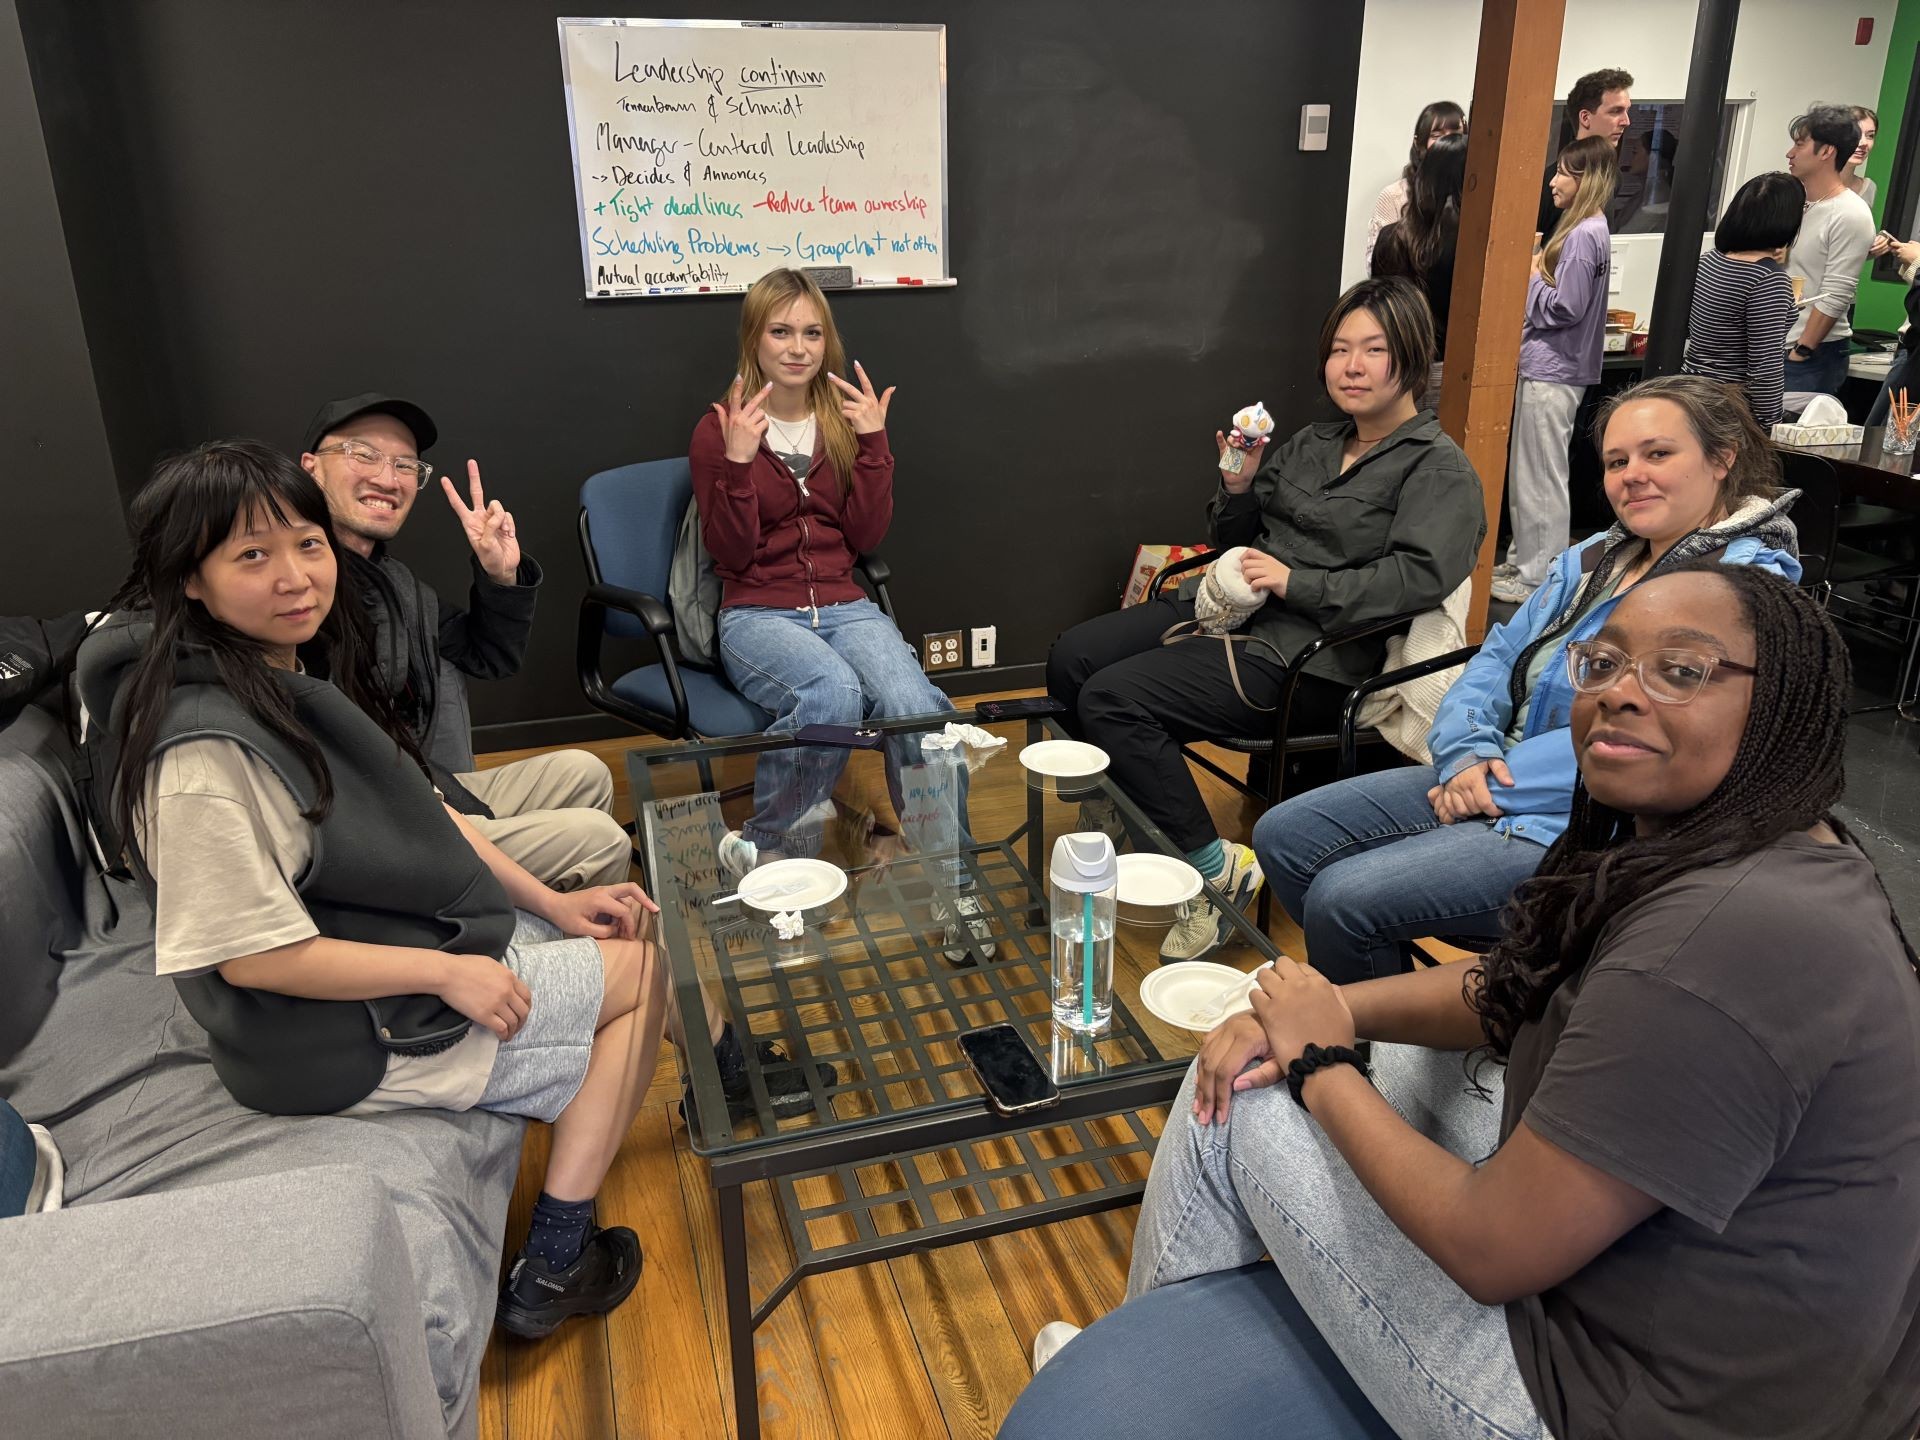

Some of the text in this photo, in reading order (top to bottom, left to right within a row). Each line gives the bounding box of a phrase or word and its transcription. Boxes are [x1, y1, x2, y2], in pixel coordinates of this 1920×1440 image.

[615, 41, 725, 96] Leadership
[725, 94, 804, 118] Schmidt
[612, 165, 675, 185] Decides
[663, 191, 744, 219] deadlines
[818, 185, 858, 215] team
[864, 190, 928, 219] ownership
[592, 226, 685, 265] Scheduling
[687, 227, 761, 257] Problems
[890, 232, 912, 254] not
[597, 262, 730, 286] Mutual accountability
[535, 1277, 566, 1293] SALOMON
